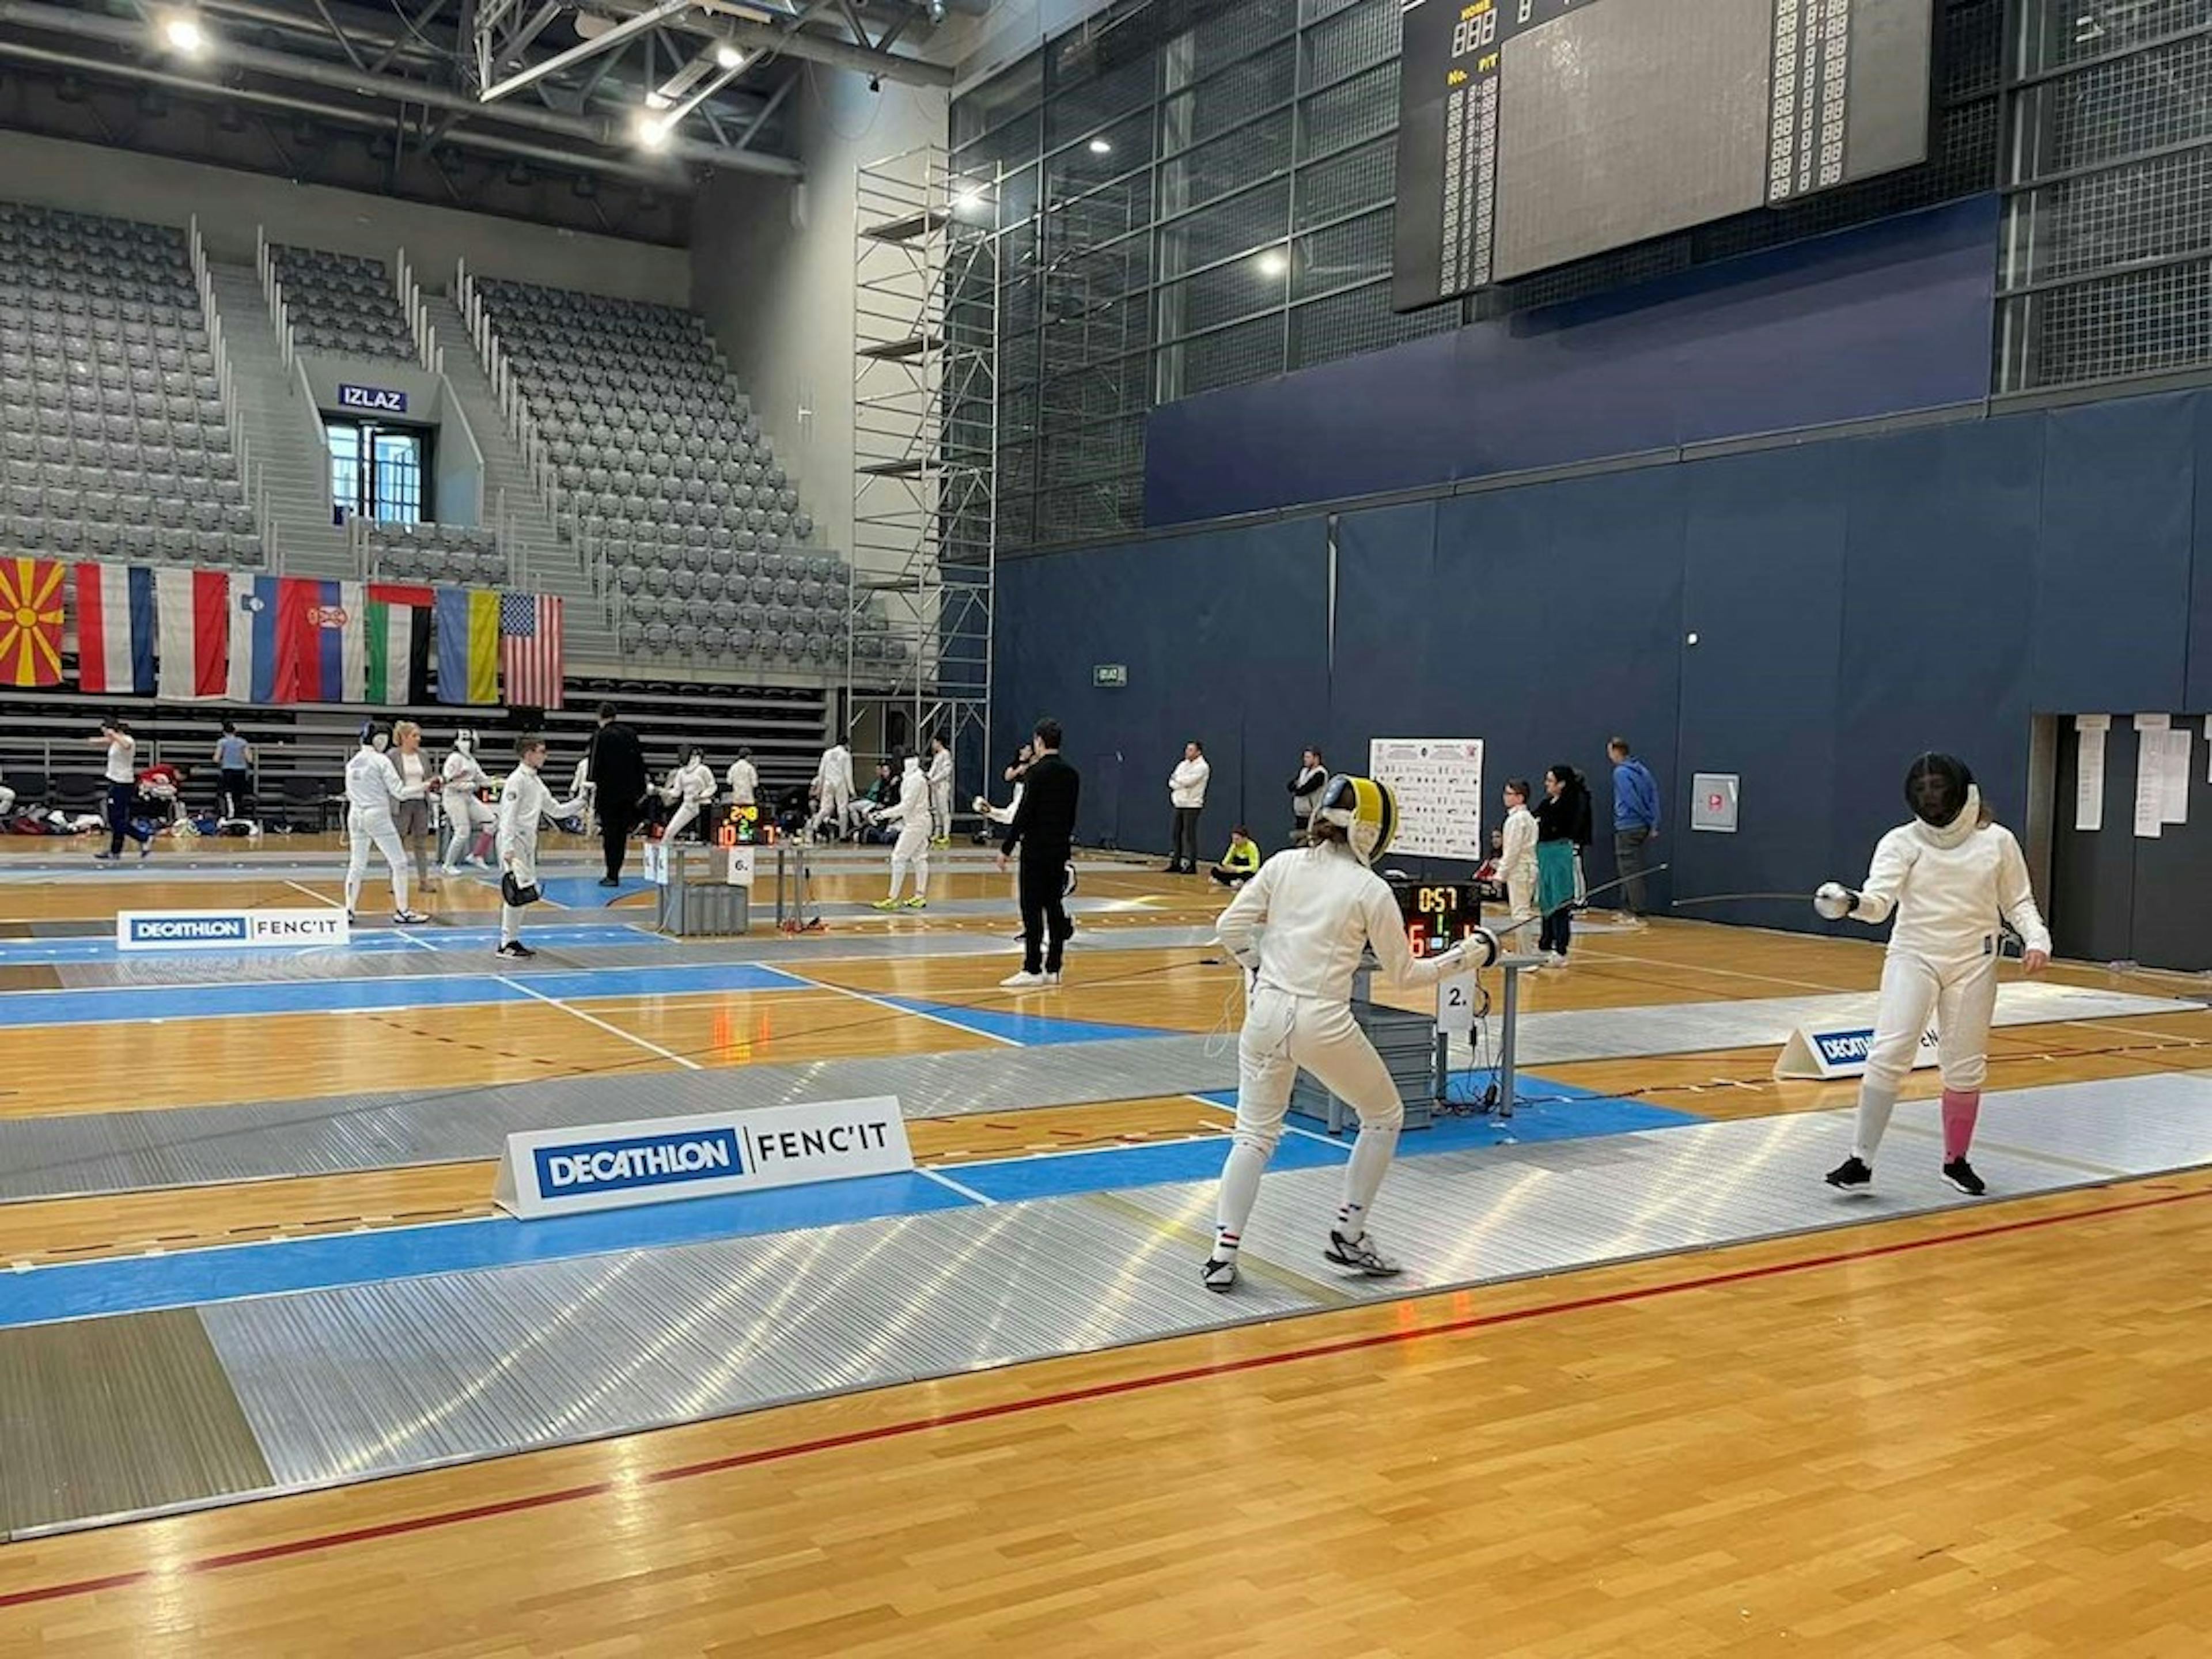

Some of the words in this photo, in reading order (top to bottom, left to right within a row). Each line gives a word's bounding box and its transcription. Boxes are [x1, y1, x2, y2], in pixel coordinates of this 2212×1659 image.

[344, 387, 402, 411] IZLAZ
[763, 825, 774, 844] 7
[735, 860, 748, 871] 6.
[1419, 888, 1457, 912] 0:57
[137, 920, 240, 938] DECATHLON
[257, 919, 337, 935] FENC'IT
[1449, 987, 1467, 1006] 2.
[549, 1138, 730, 1187] DECATHLON
[757, 1122, 887, 1161] FENC'IT
